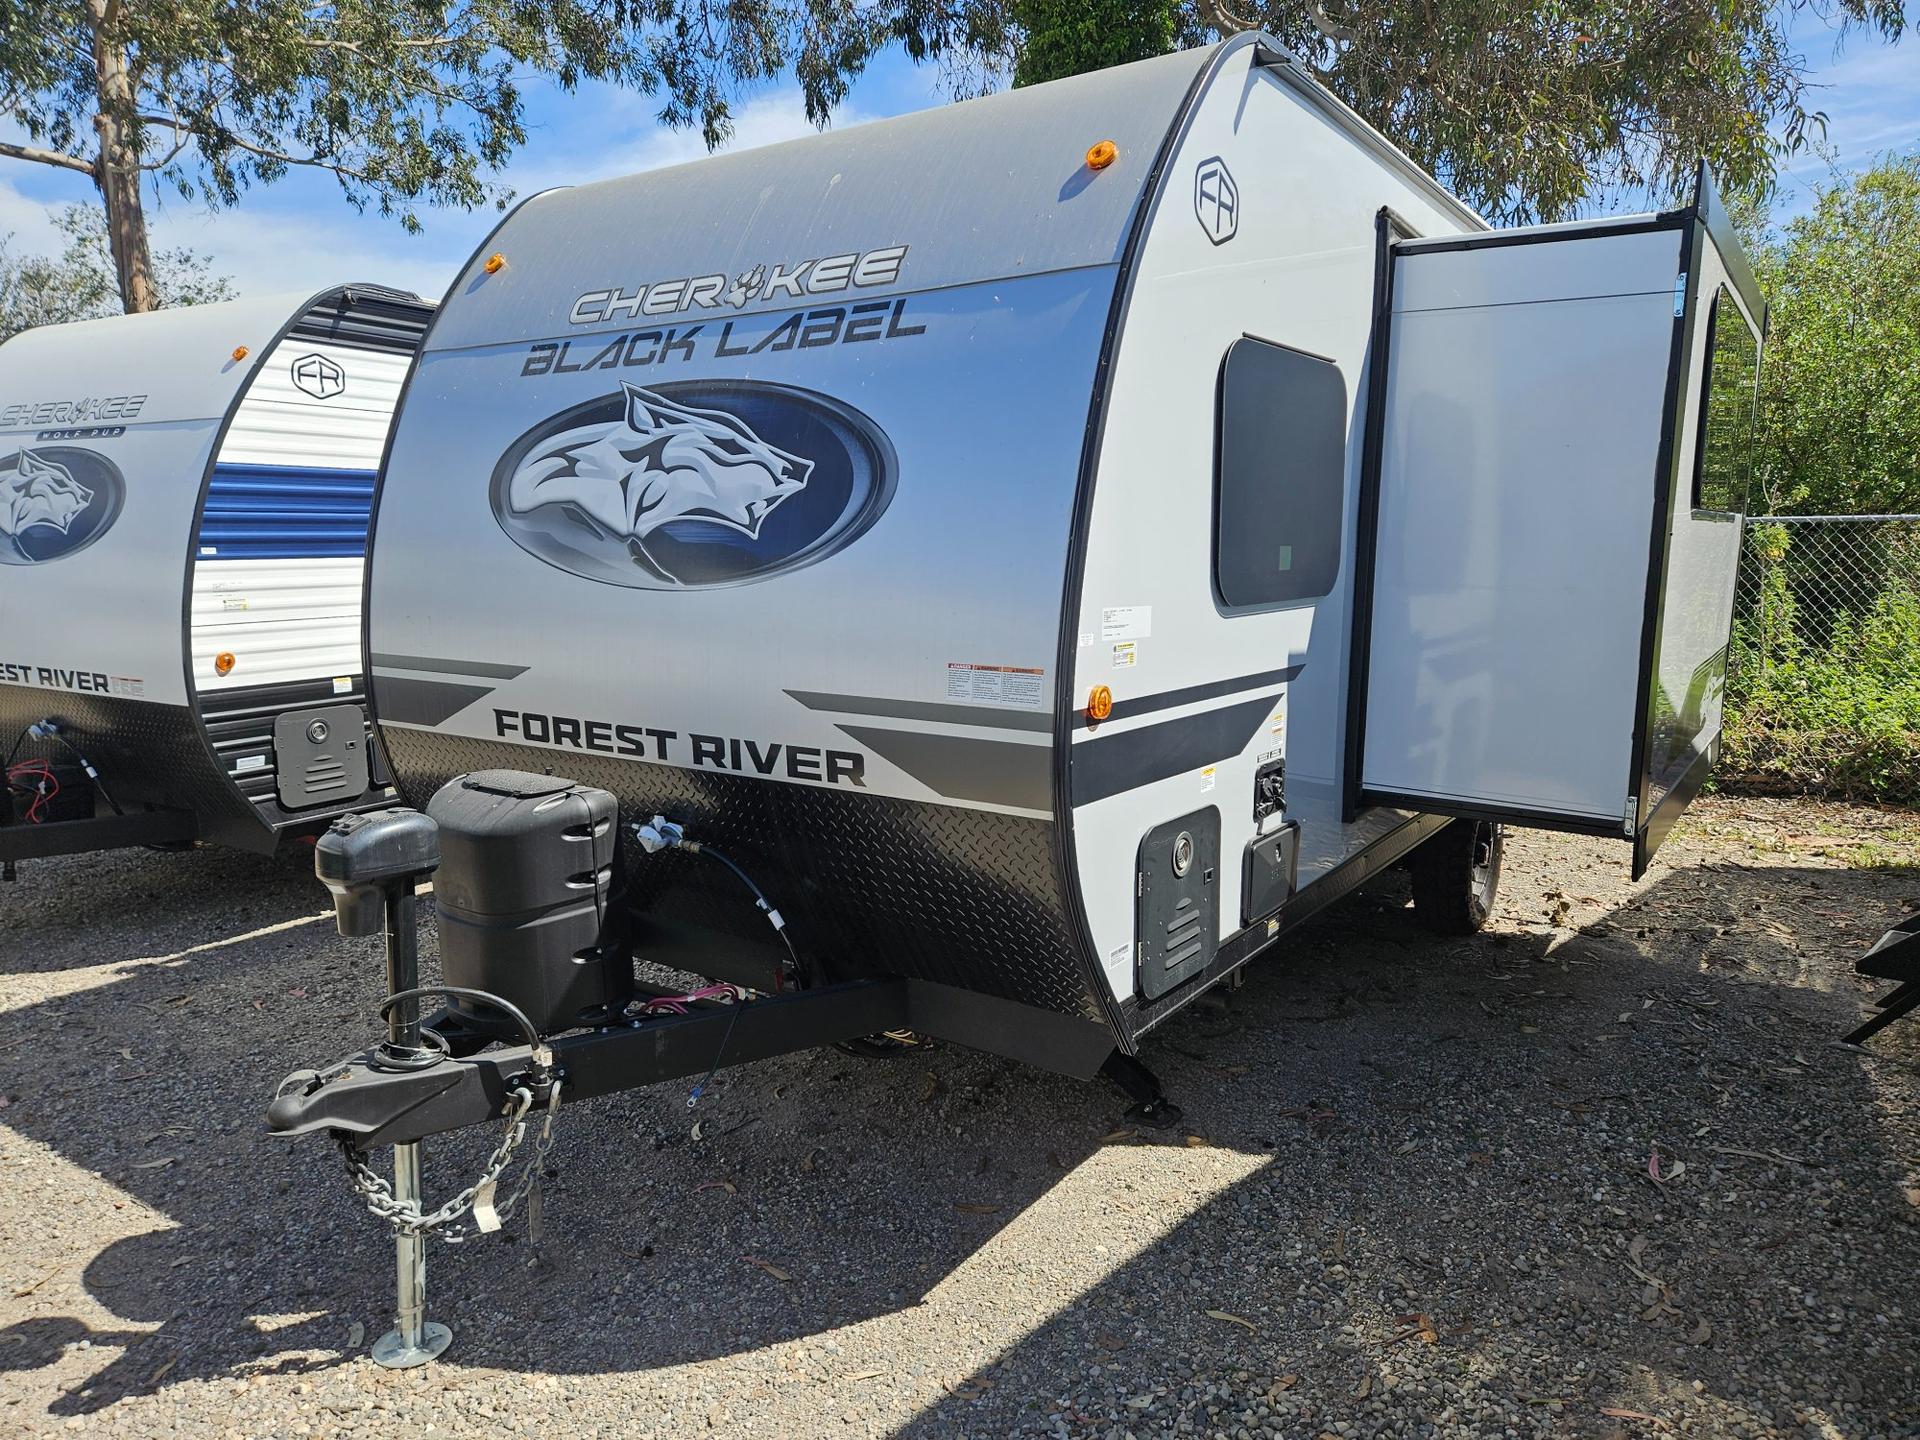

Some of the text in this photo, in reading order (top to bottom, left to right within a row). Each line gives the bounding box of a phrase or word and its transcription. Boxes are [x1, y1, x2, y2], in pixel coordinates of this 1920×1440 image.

[520, 298, 927, 377] BLACK LABEL
[42, 427, 121, 440] WOLF PUP
[37, 666, 110, 693] RIVER
[492, 708, 867, 787] FOREST RIVER
